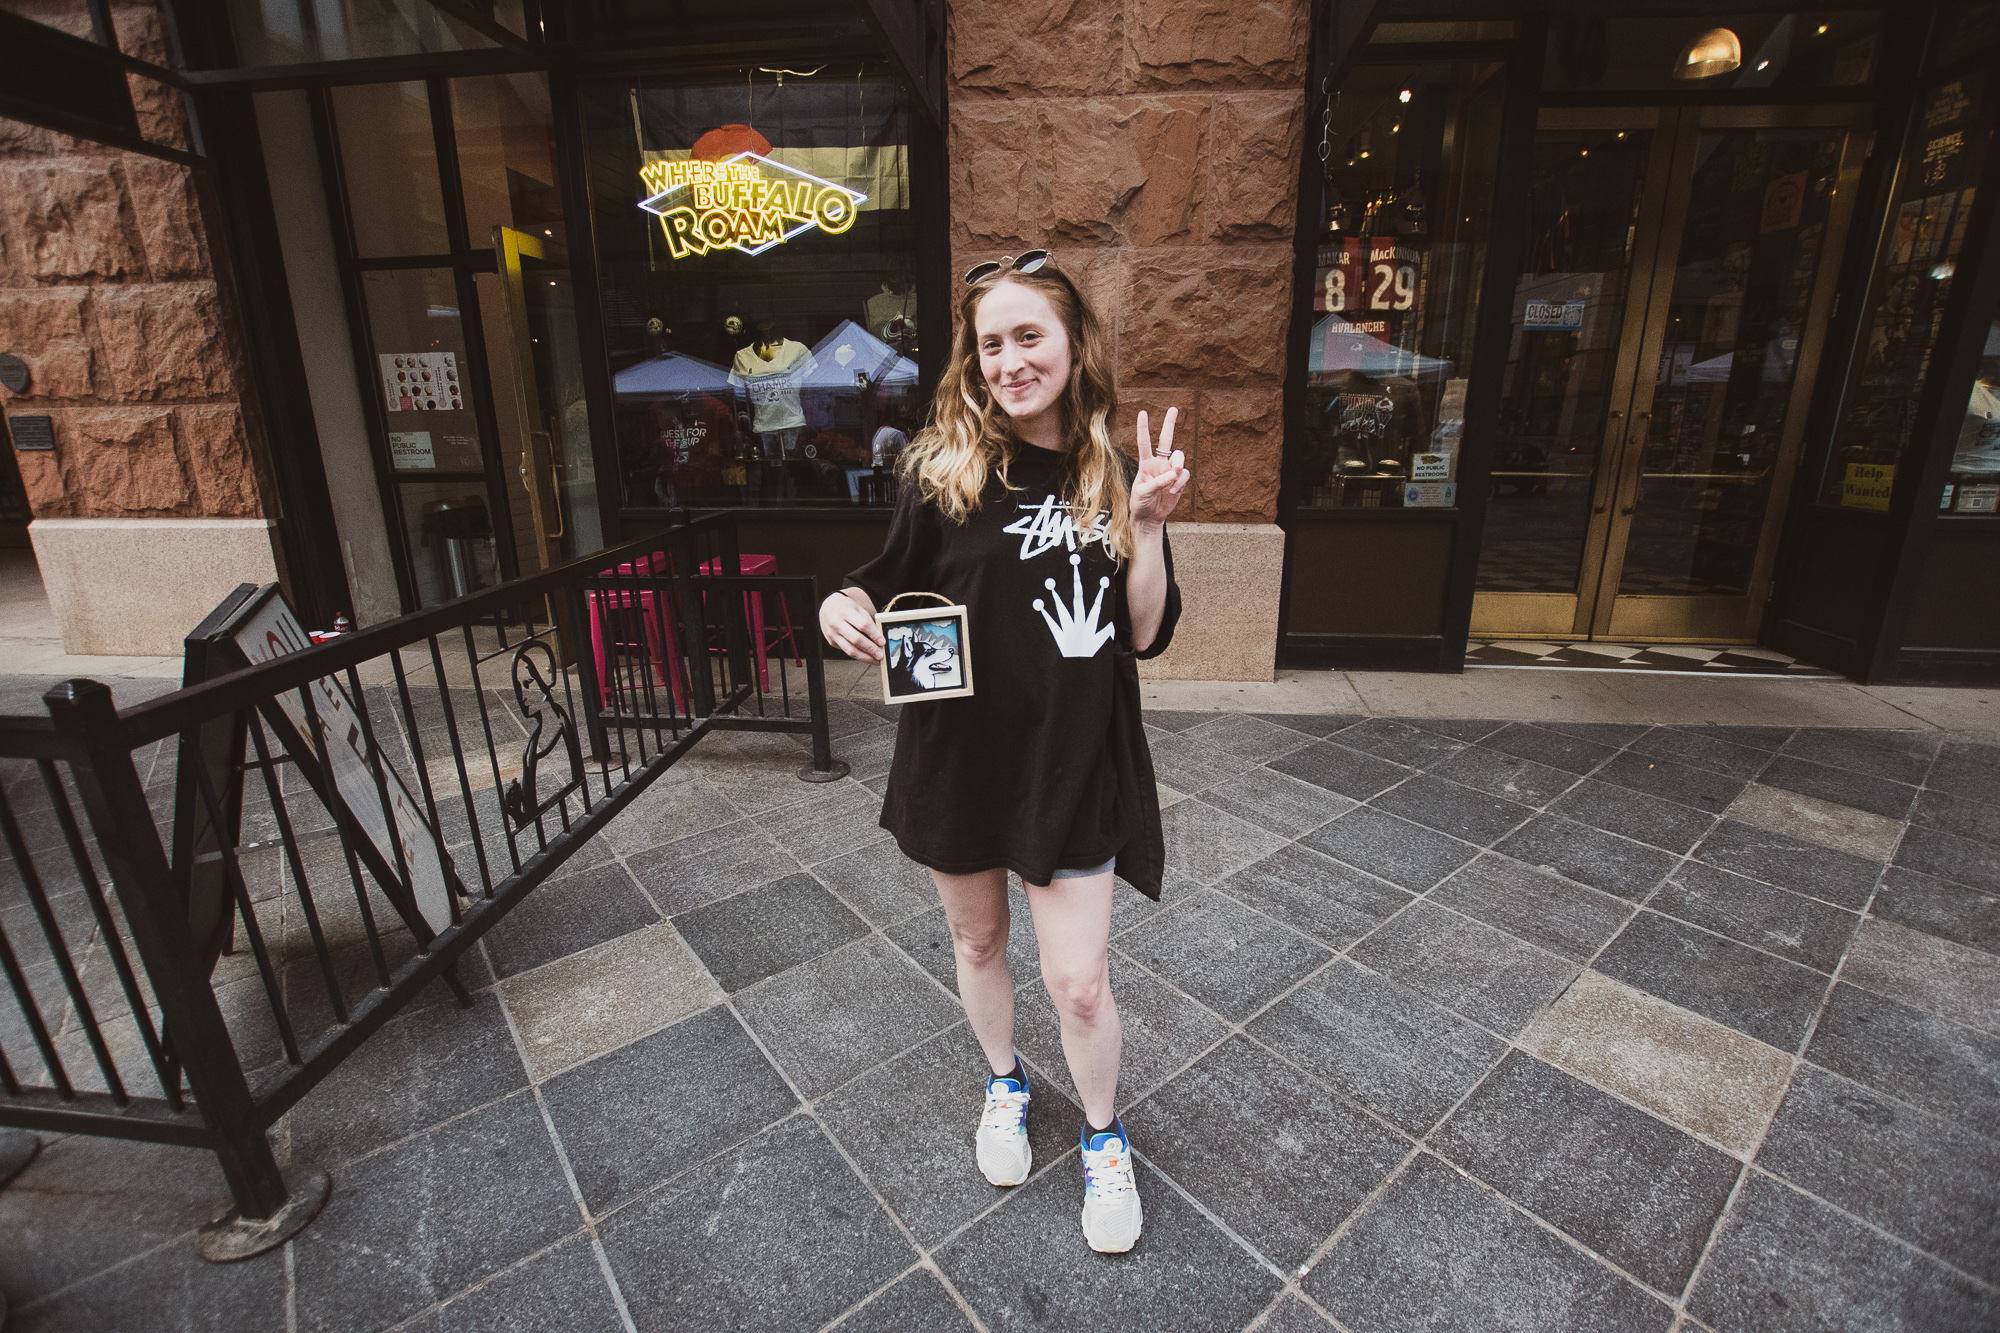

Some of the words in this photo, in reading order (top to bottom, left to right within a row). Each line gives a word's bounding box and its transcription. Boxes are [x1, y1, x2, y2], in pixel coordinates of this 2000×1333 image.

[640, 161, 728, 195] WHERE
[728, 163, 760, 181] THE
[693, 180, 857, 234] BUFFALO
[659, 206, 787, 259] ROAM
[1318, 251, 1350, 267] MAKAR
[1325, 269, 1345, 312] 8
[1370, 264, 1415, 310] 29
[1528, 304, 1562, 318] CLOSED
[1331, 321, 1385, 333] AVALANCHE
[752, 378, 793, 393] CHAMPS
[686, 427, 707, 437] FOR
[1855, 466, 1884, 482] Help
[1843, 484, 1890, 499] Wanted
